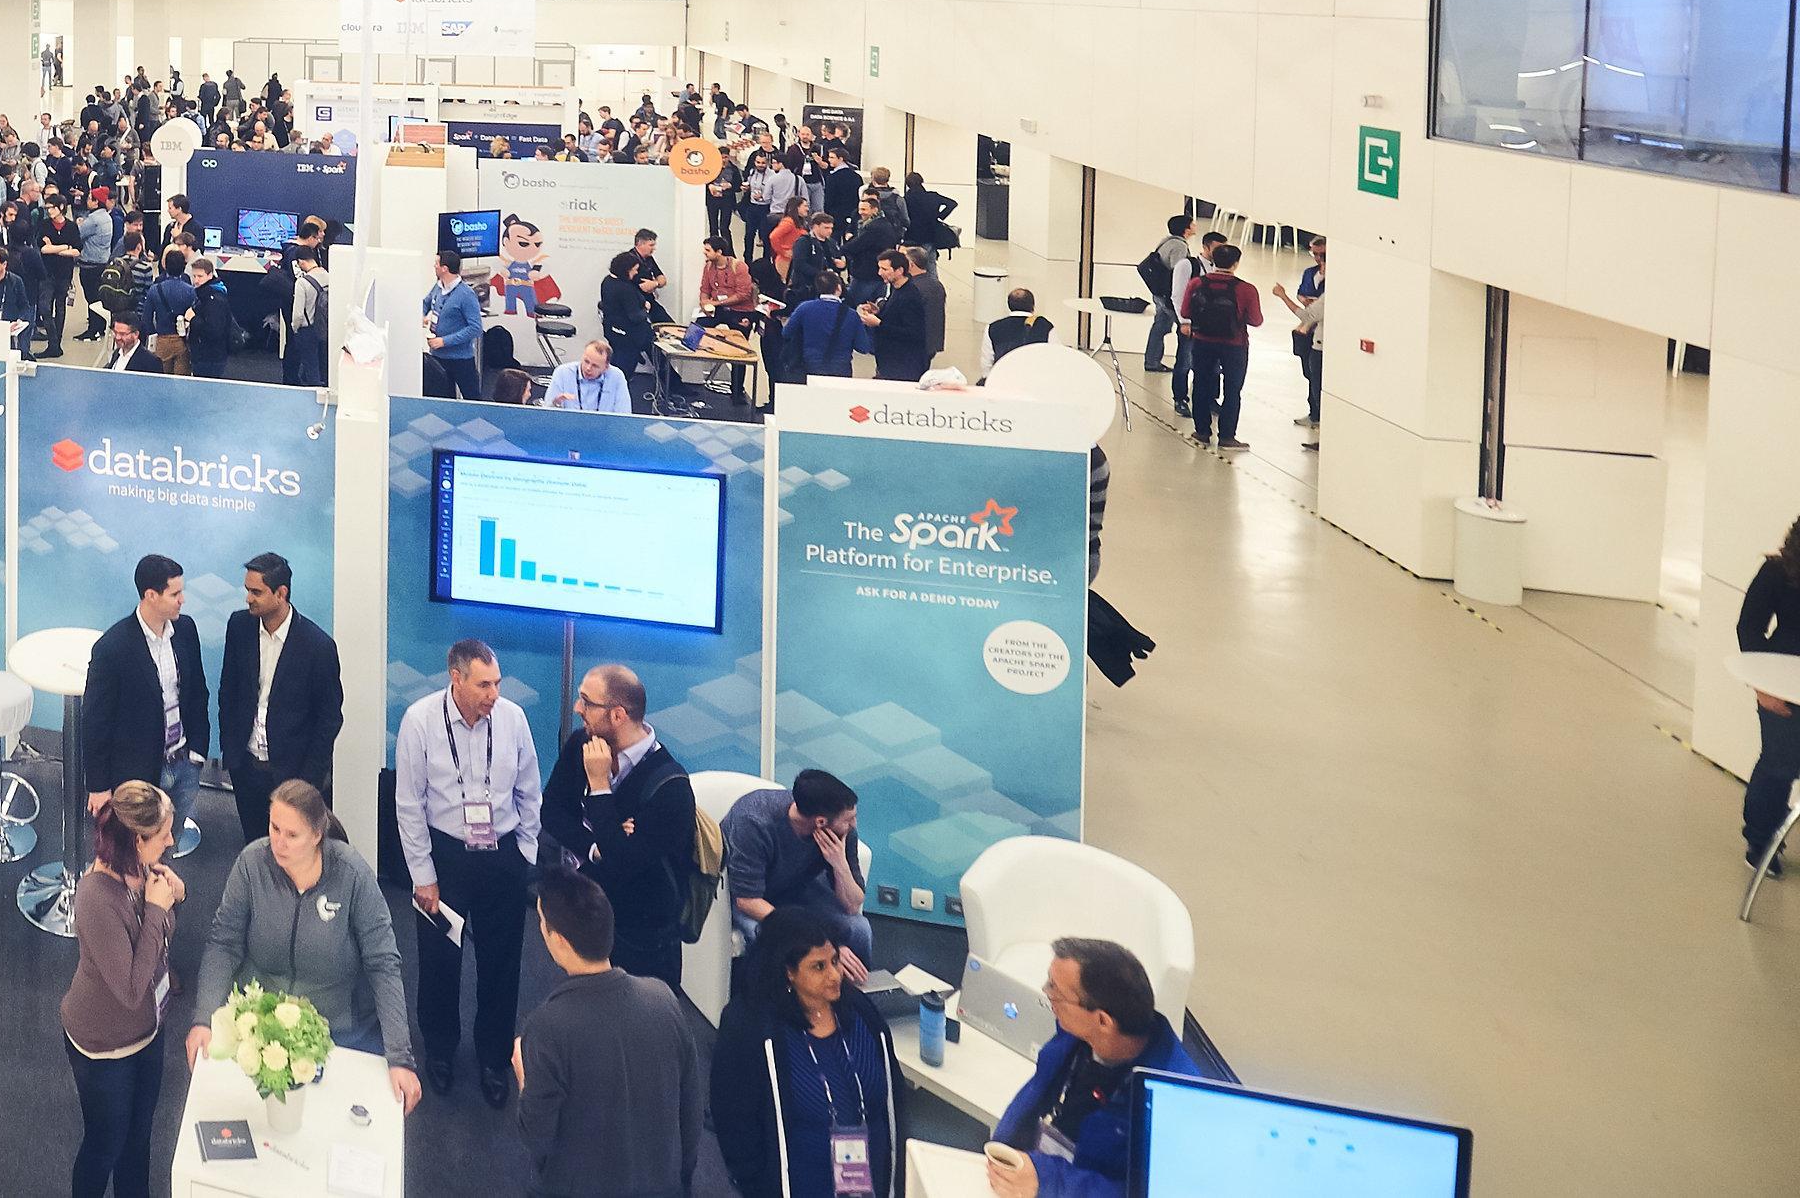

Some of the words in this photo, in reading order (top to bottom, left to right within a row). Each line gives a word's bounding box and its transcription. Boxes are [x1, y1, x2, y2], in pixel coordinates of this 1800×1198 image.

[341, 23, 383, 32] cloura
[442, 22, 470, 35] SAP
[453, 132, 472, 141] Spark
[160, 141, 182, 151] IBM
[296, 163, 314, 173] IBM
[322, 163, 346, 175] Spark
[680, 166, 711, 176] basho
[522, 177, 557, 189] basho
[568, 198, 598, 211] riak
[464, 222, 488, 232] basho
[874, 404, 1013, 433] databricks
[88, 437, 301, 497] databricks
[108, 483, 155, 503] making
[157, 487, 179, 506] big
[180, 492, 209, 507] data
[211, 494, 256, 513] simple
[917, 512, 967, 524] APACHE
[843, 521, 884, 542] The
[889, 513, 1003, 552] Spark
[806, 544, 897, 569] Platform
[903, 554, 934, 573] for
[939, 557, 1058, 585] Enterprise.
[856, 586, 880, 598] ASK
[882, 588, 908, 600] FOR
[909, 591, 918, 601] A
[920, 592, 956, 605] DEMO
[959, 596, 1000, 610] TODAY
[1005, 639, 1029, 647] FROM
[988, 647, 1032, 658] CREATORS
[1048, 653, 1064, 661] THE
[992, 657, 1025, 666] APACHE
[1029, 660, 1057, 670] SPARK
[1006, 668, 1045, 678] PROJECT
